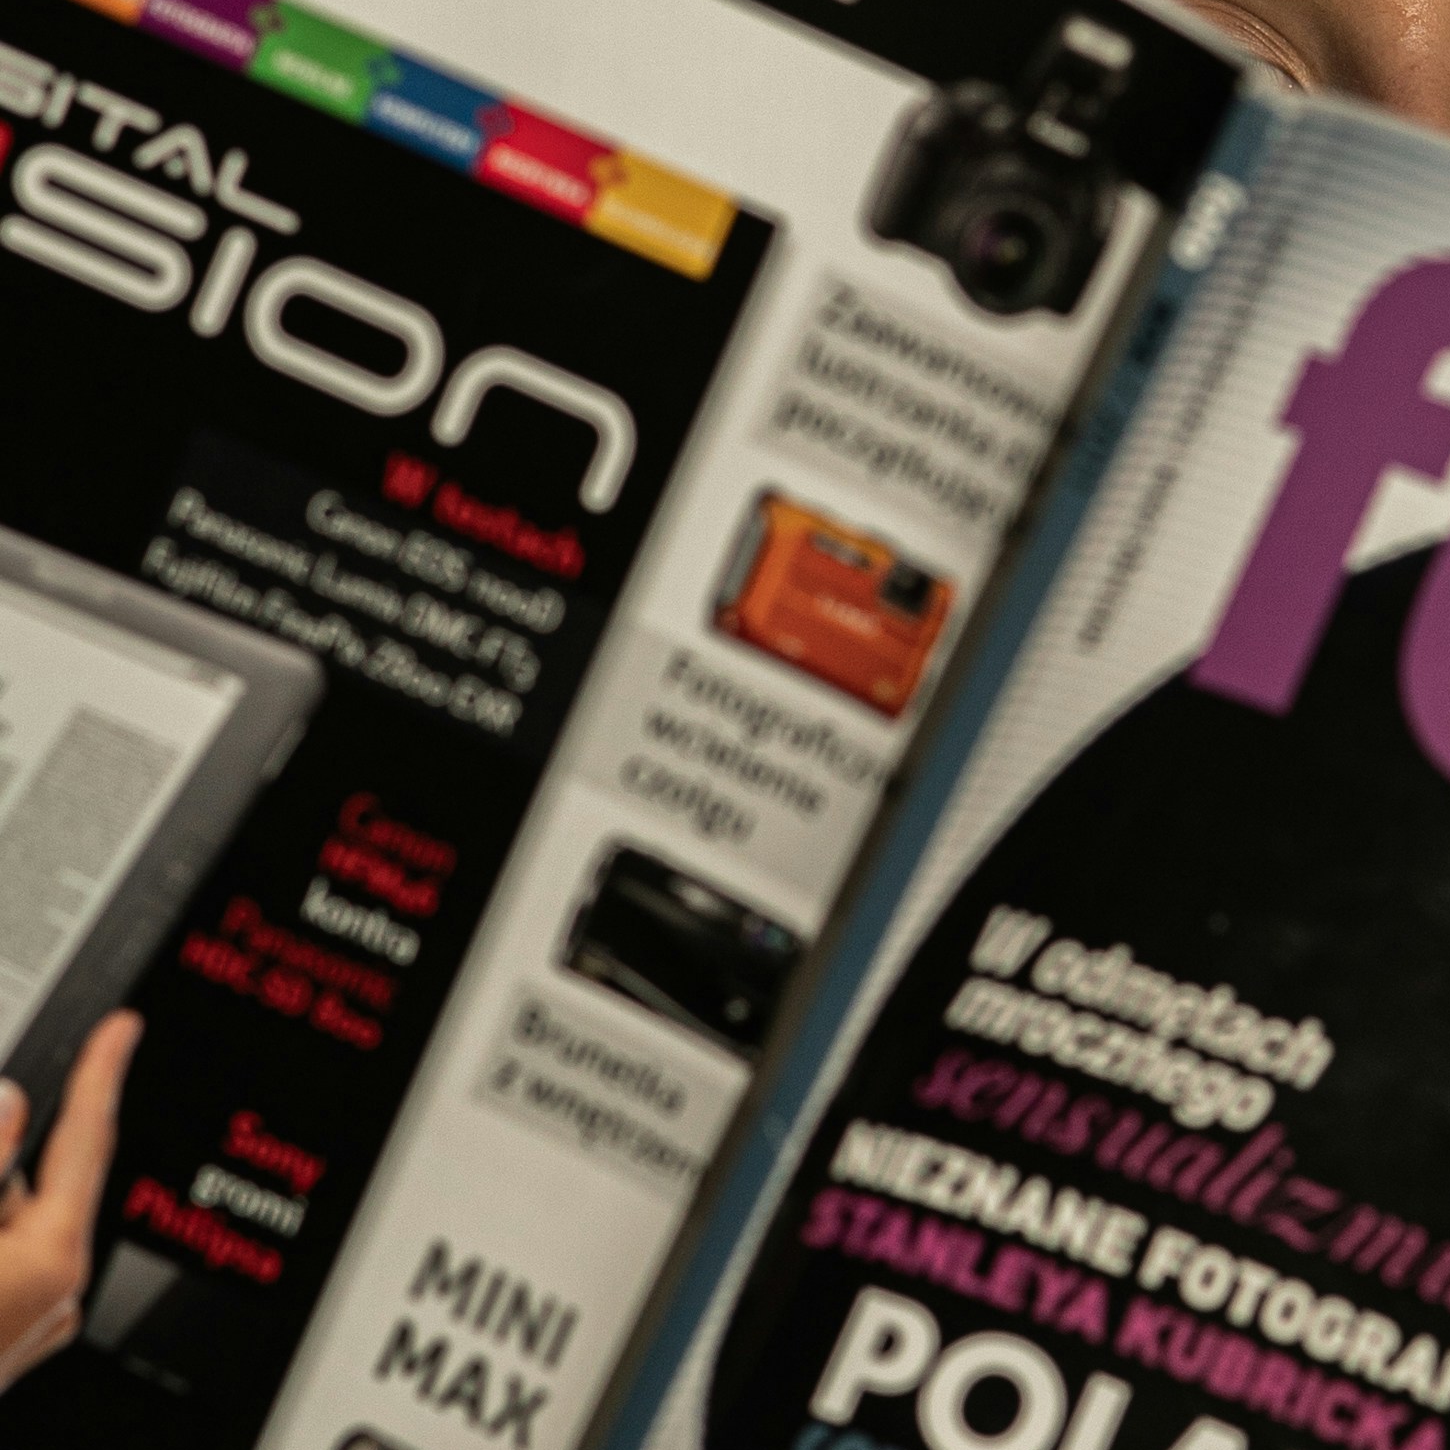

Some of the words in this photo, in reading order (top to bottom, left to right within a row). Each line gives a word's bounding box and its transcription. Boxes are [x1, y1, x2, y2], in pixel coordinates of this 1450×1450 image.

[968, 904, 1051, 978] W
[943, 975, 1276, 1133] mrocznego
[801, 1189, 1112, 1346] STANLEYA
[830, 1118, 1147, 1279] NIEZNANE
[407, 1236, 581, 1372] MINI
